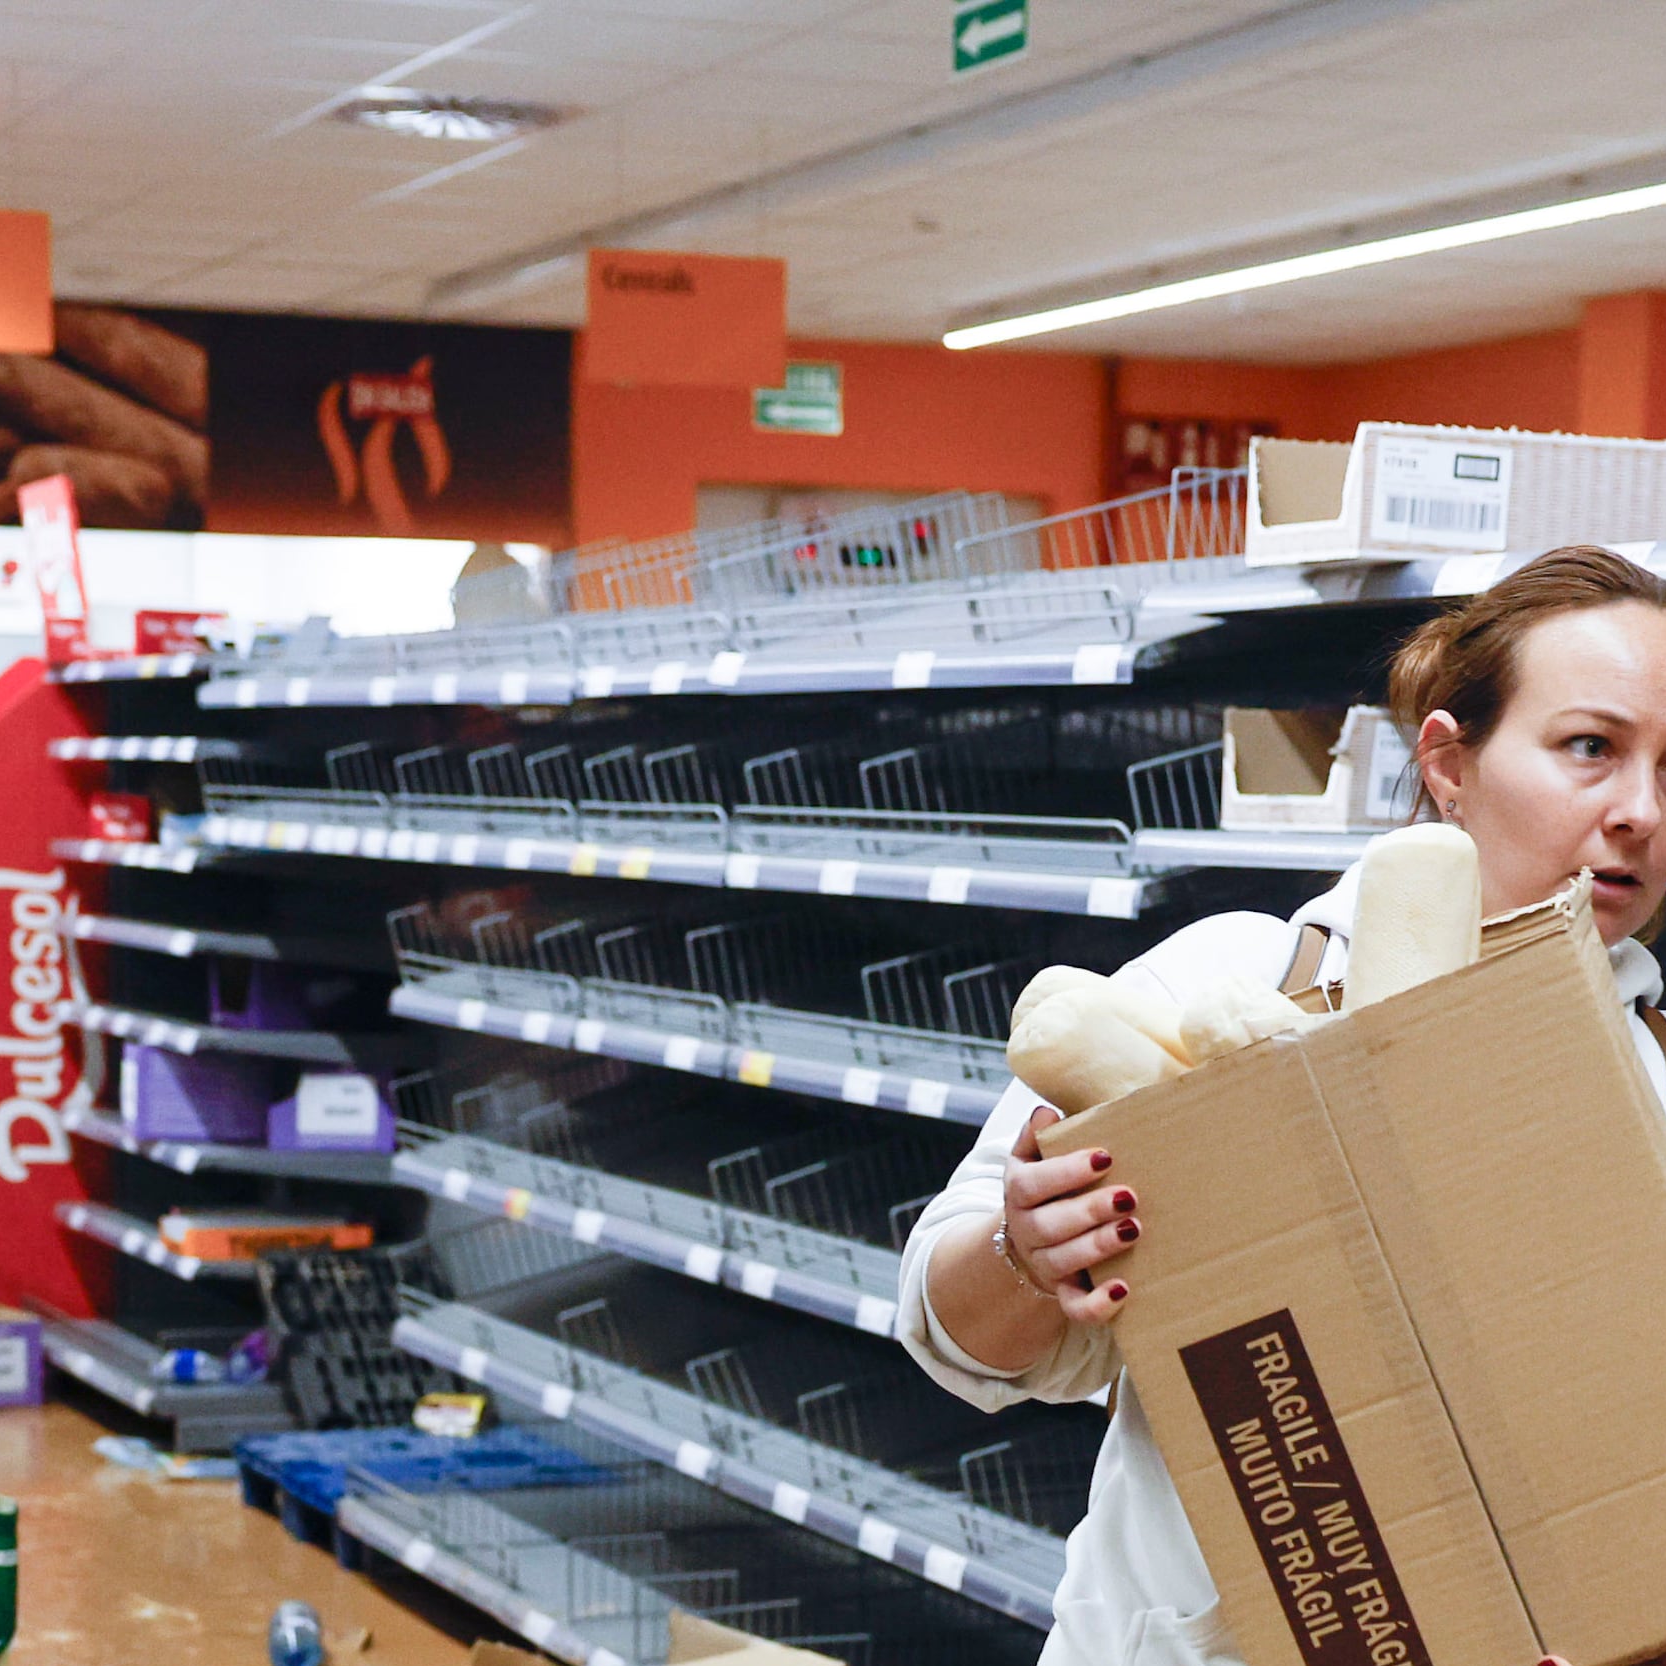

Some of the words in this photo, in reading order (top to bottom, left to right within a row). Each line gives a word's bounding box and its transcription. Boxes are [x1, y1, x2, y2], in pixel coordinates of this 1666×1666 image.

[1225, 1417, 1295, 1527] MUITO
[1271, 1528, 1344, 1650] FRÁGIL
[1245, 1331, 1330, 1474] FRAGILE
[1312, 1500, 1372, 1577] MUY
